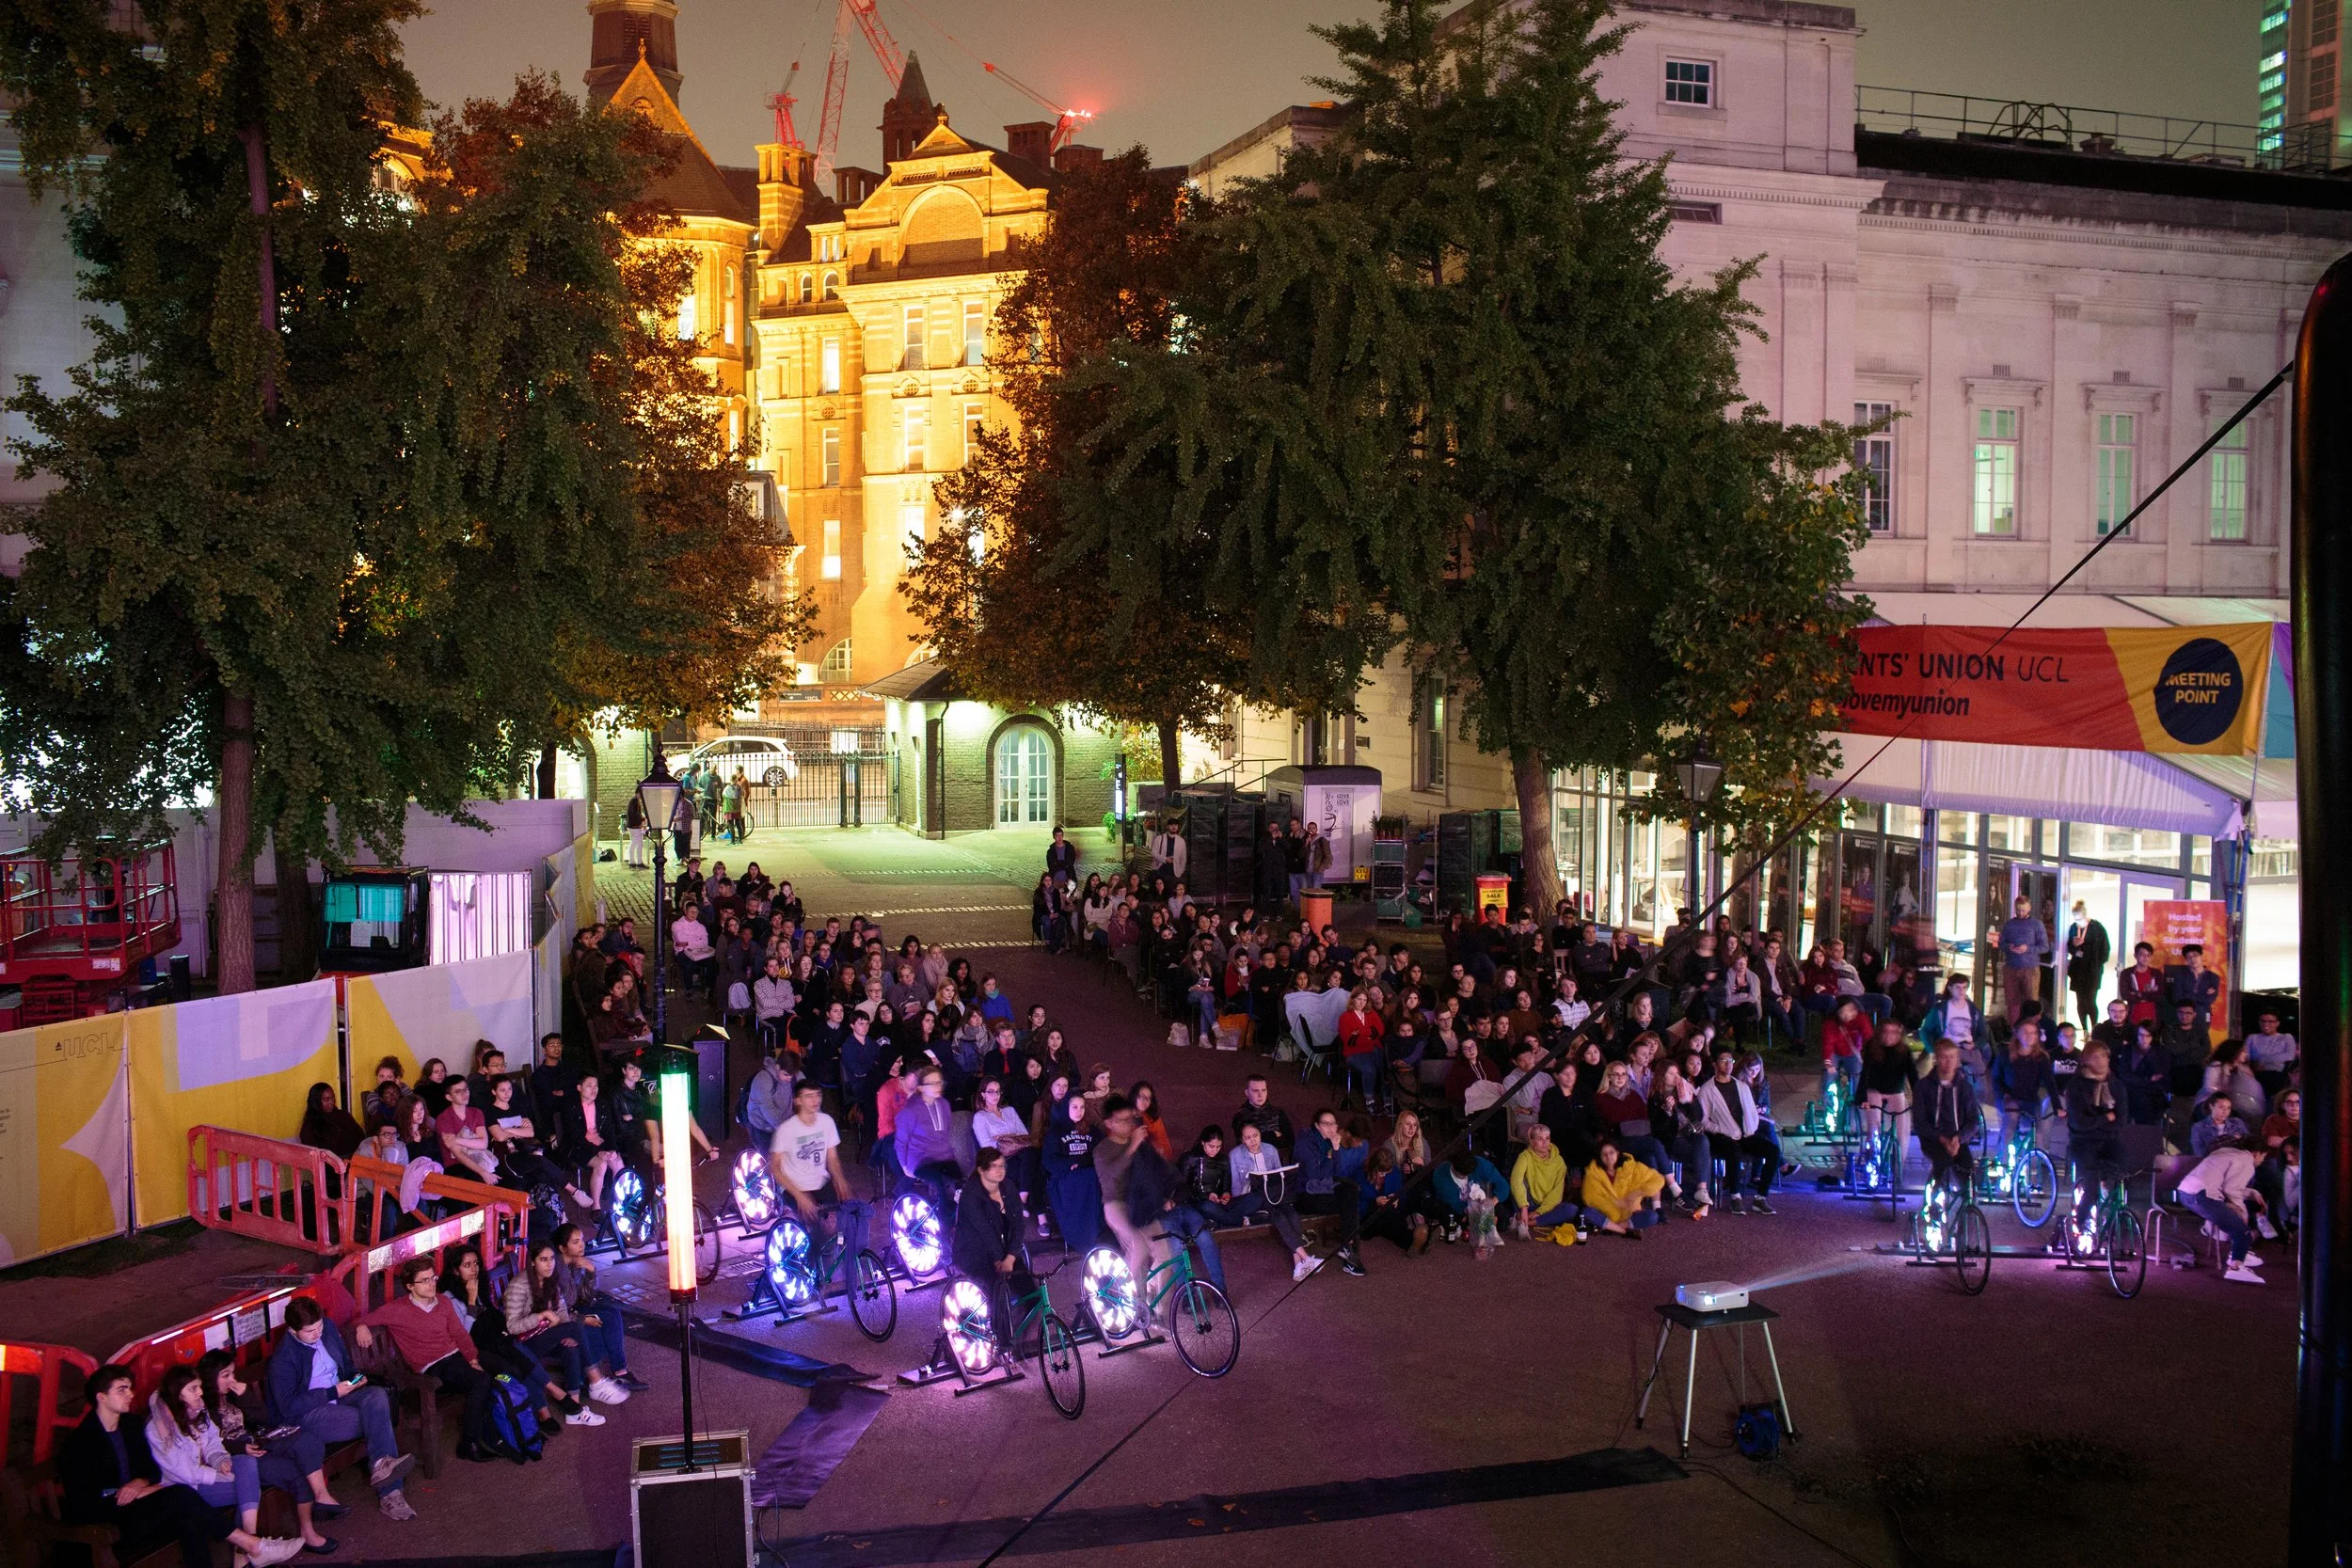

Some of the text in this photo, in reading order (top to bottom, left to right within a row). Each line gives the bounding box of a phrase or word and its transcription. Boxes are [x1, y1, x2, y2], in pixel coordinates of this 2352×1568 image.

[1918, 653, 2005, 681] UNION
[2017, 656, 2070, 683] UCL
[2165, 672, 2232, 687] MEETING
[2174, 689, 2220, 705] POINT
[2168, 913, 2202, 922] Hosted
[2167, 925, 2203, 935] by your
[62, 1032, 116, 1062] UCL
[813, 1151, 821, 1164] 8
